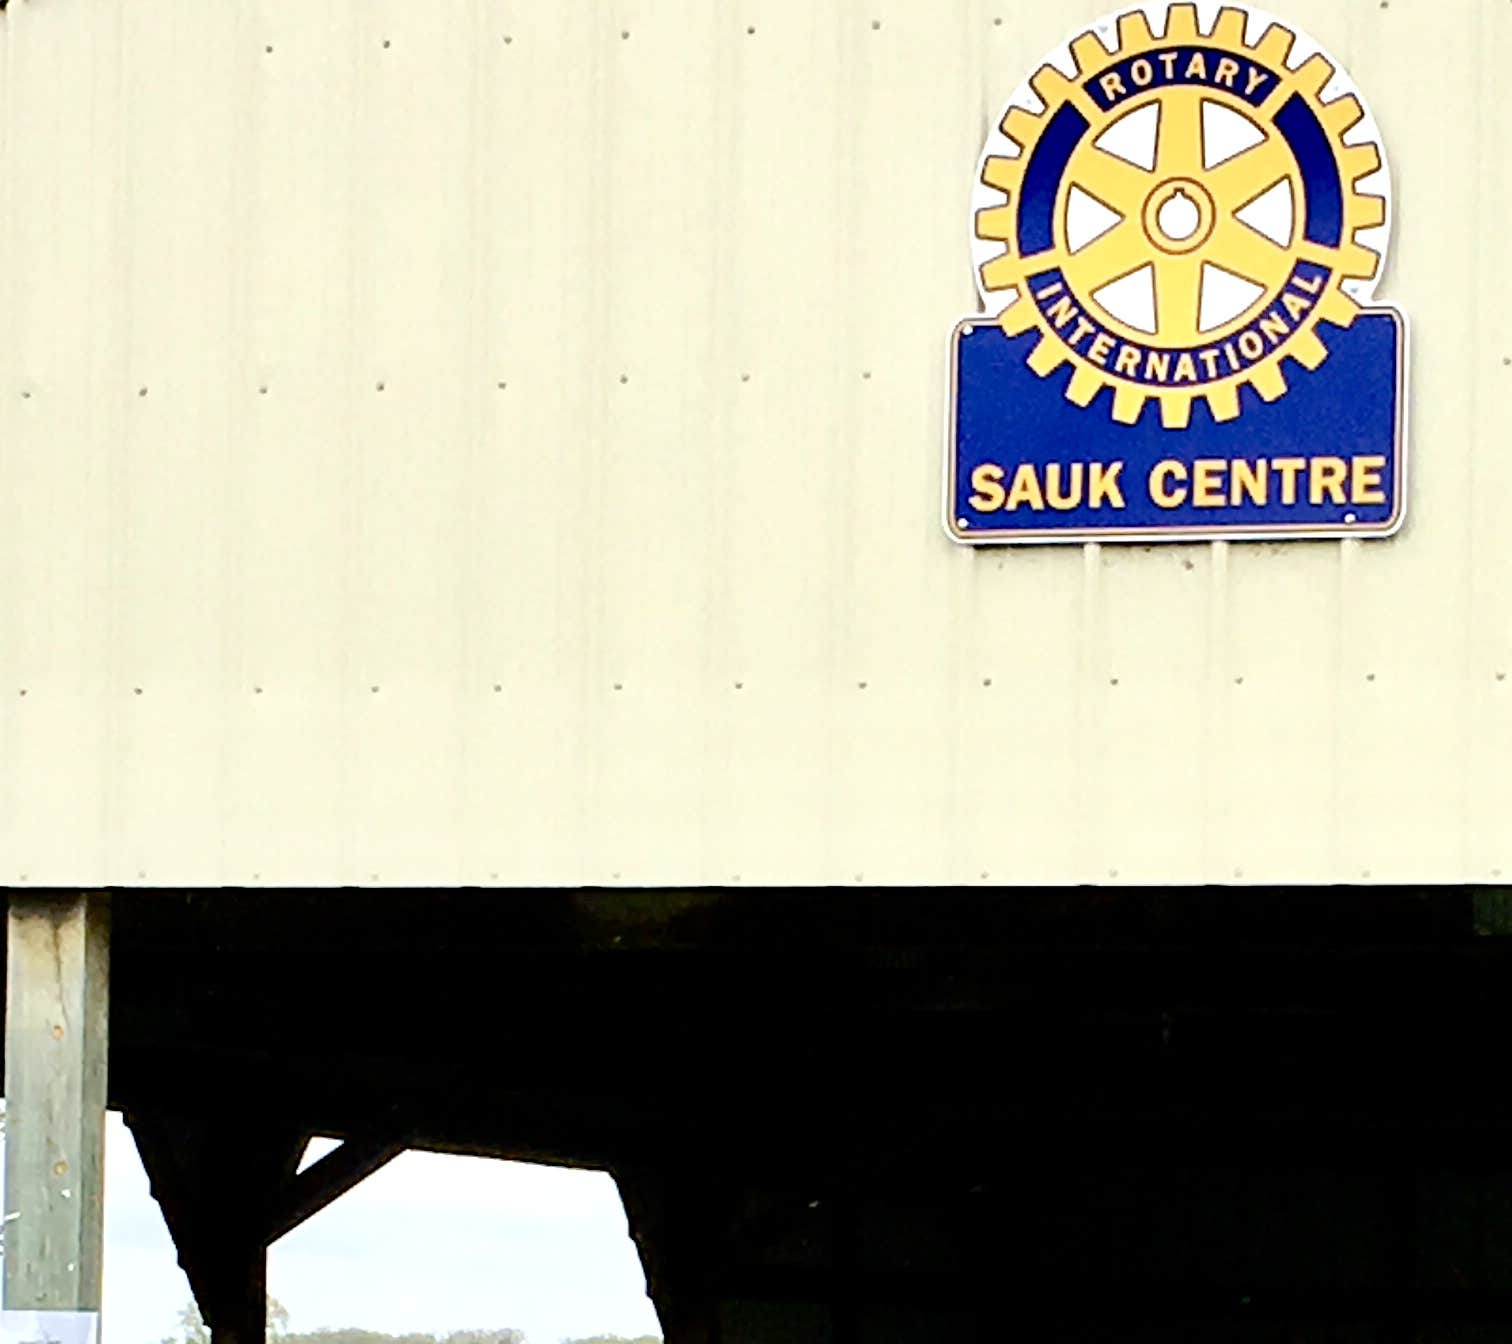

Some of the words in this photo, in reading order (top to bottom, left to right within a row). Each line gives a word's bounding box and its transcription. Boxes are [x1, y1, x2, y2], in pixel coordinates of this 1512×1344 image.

[1101, 52, 1269, 100] ROTARY
[1036, 273, 1323, 383] INTERNATIONAL
[969, 462, 1126, 512] SAUK
[1149, 456, 1387, 510] CENTRE
